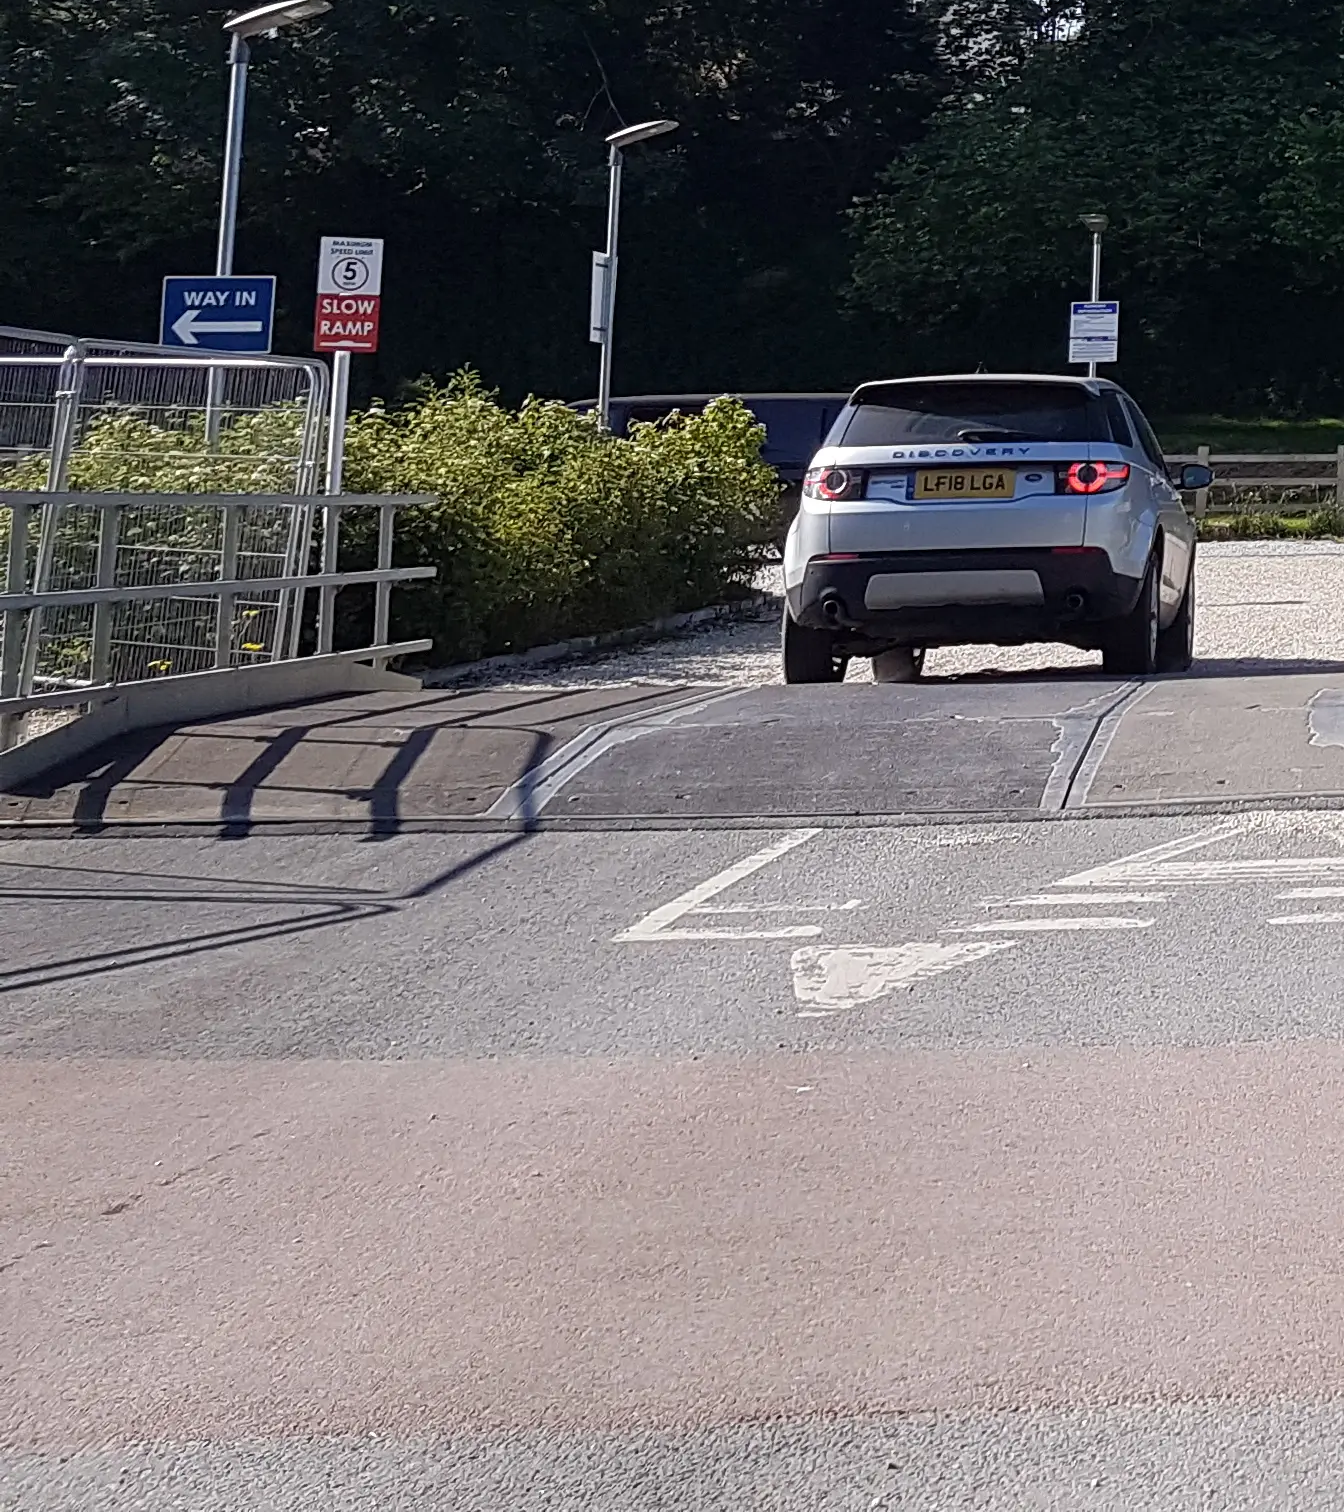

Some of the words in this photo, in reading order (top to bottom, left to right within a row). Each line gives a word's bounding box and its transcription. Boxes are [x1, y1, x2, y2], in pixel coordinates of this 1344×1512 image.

[342, 261, 358, 281] 5
[183, 291, 230, 307] WAY
[235, 290, 256, 306] IN
[321, 299, 375, 315] SLOW
[320, 320, 374, 336] RAMP
[892, 447, 1030, 459] DISCOVERY
[970, 473, 1006, 491] LGA
